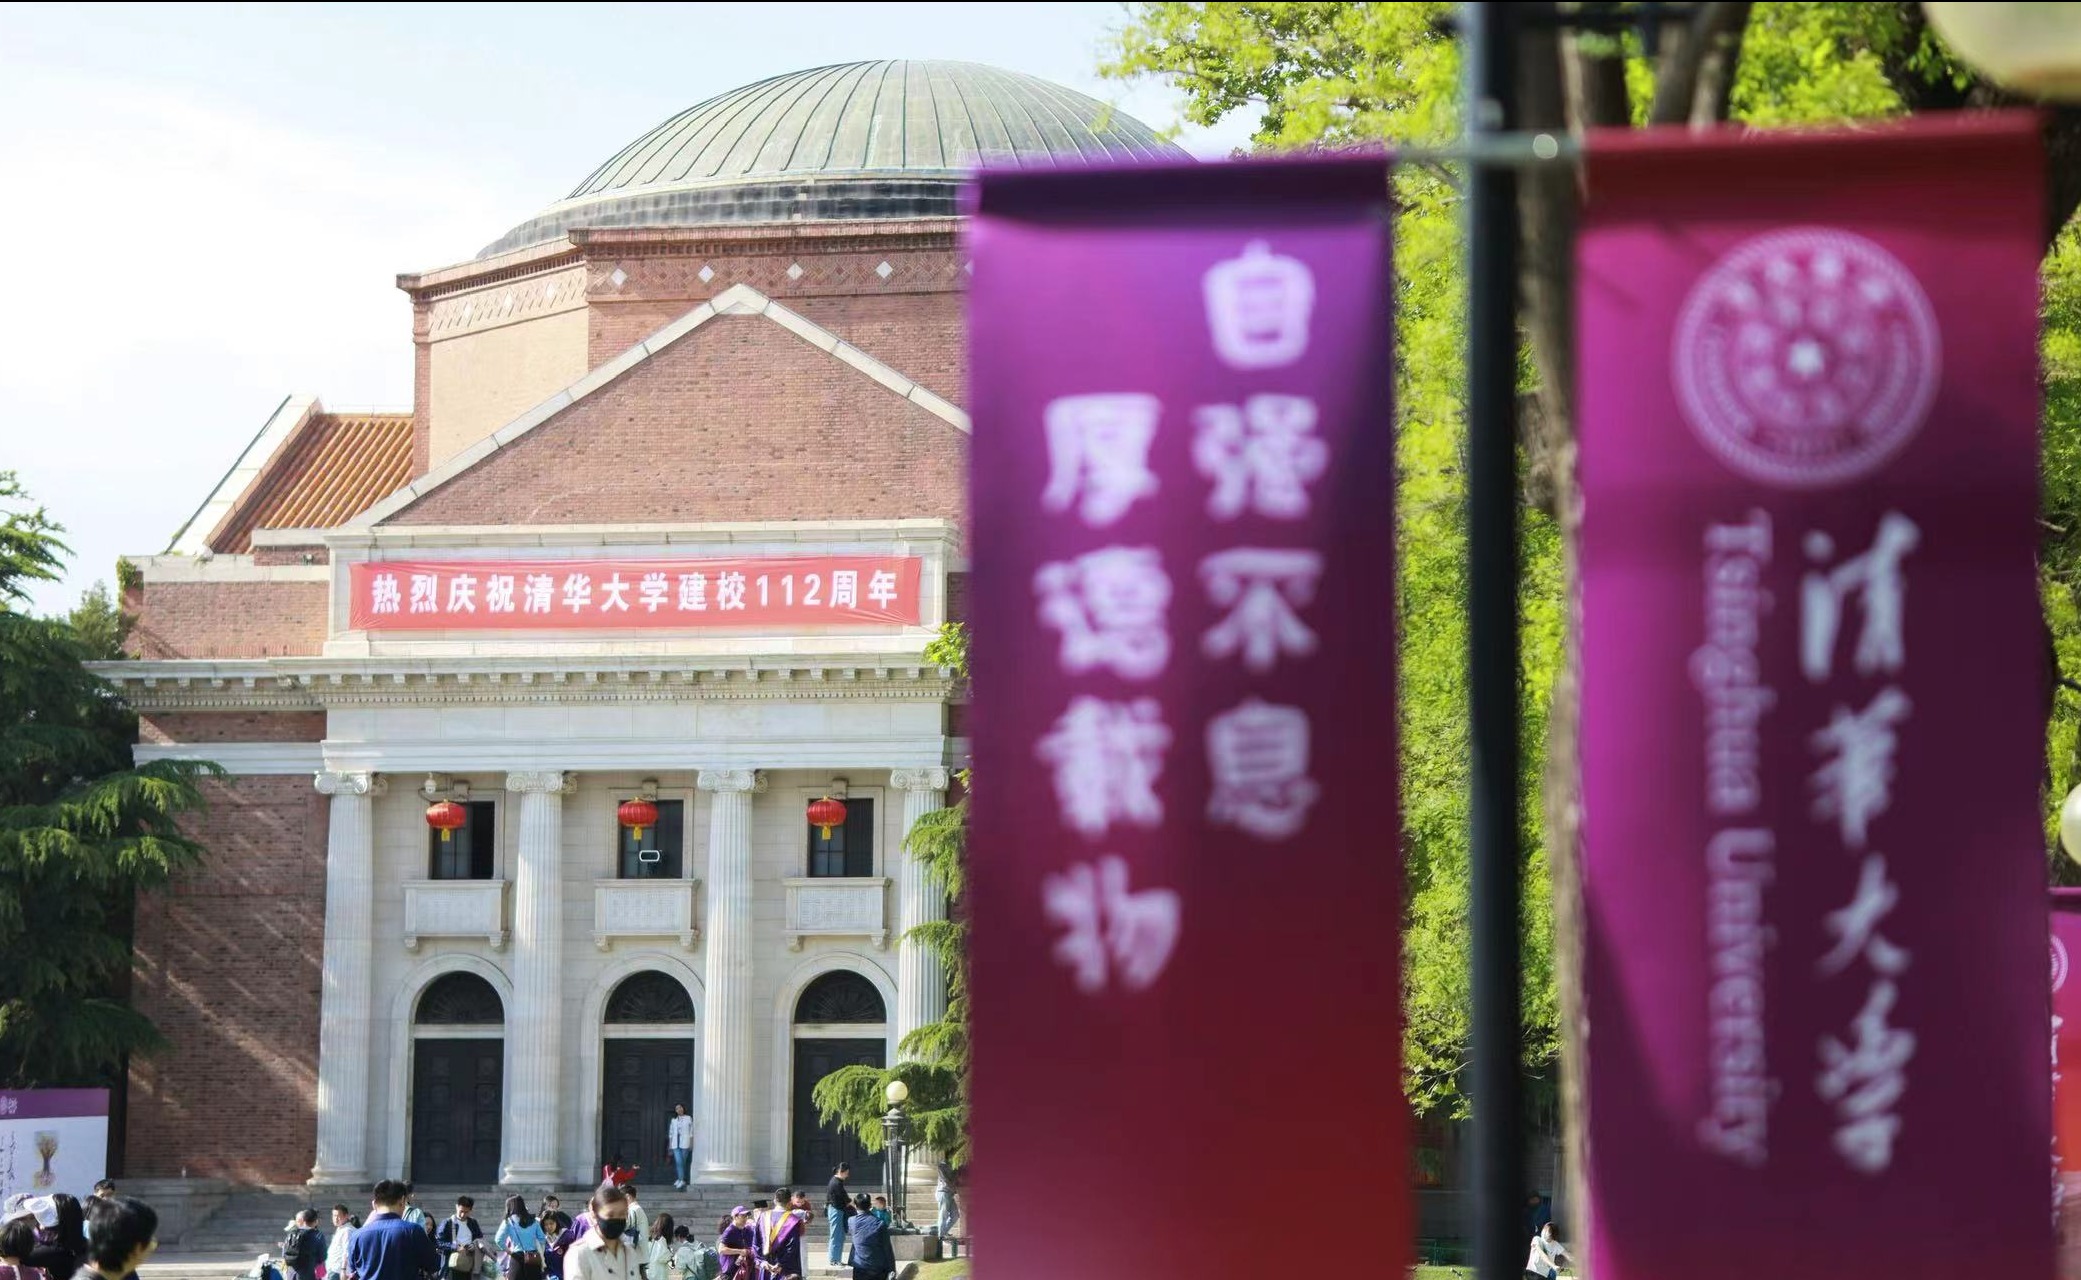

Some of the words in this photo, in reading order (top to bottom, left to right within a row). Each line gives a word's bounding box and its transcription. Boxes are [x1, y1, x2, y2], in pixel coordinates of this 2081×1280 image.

[372, 569, 898, 614] 热烈庆祝清华大学建校112周年
[1689, 509, 1774, 813] Tsinghua
[1697, 828, 1779, 1167] University
